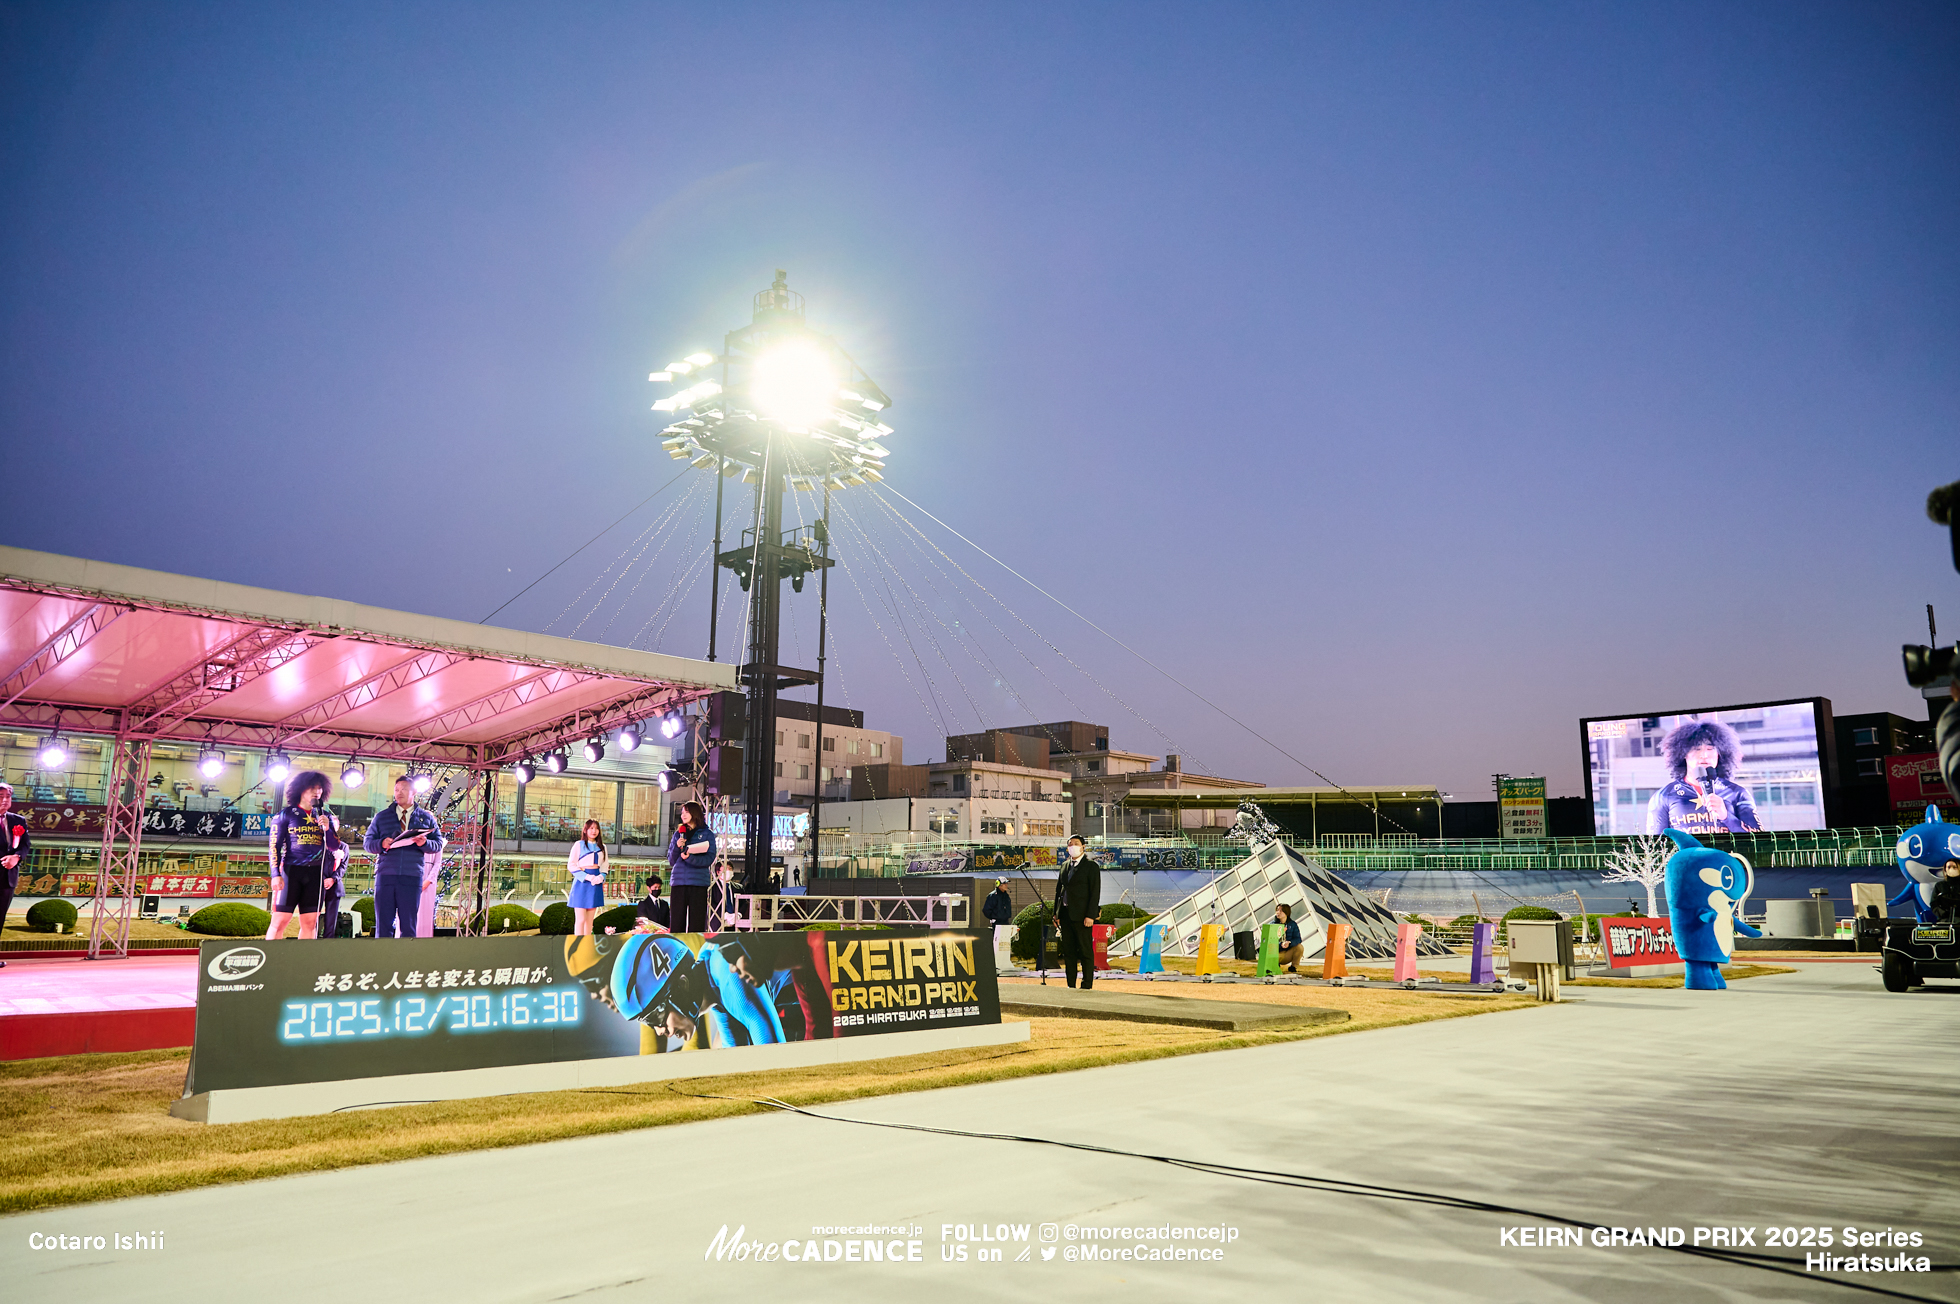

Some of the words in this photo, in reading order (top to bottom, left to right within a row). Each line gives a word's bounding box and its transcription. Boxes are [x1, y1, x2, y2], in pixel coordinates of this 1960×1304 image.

[288, 826, 320, 834] CHAMP
[771, 838, 796, 851] ate
[1106, 926, 1112, 938] 3
[1159, 926, 1166, 937] 4
[1609, 924, 1678, 957] 競輪アプリはチャ
[649, 941, 672, 980] 4
[828, 939, 975, 983] KEIRIN
[313, 966, 553, 993] 来るぞ、人生を変える瞬間が。
[832, 983, 922, 1011] GRAND
[925, 981, 979, 1005] PRIX
[284, 991, 578, 1039] 2025.12/30.16:30
[833, 1015, 865, 1027] 2025
[866, 1009, 927, 1025] HIRATSUKA
